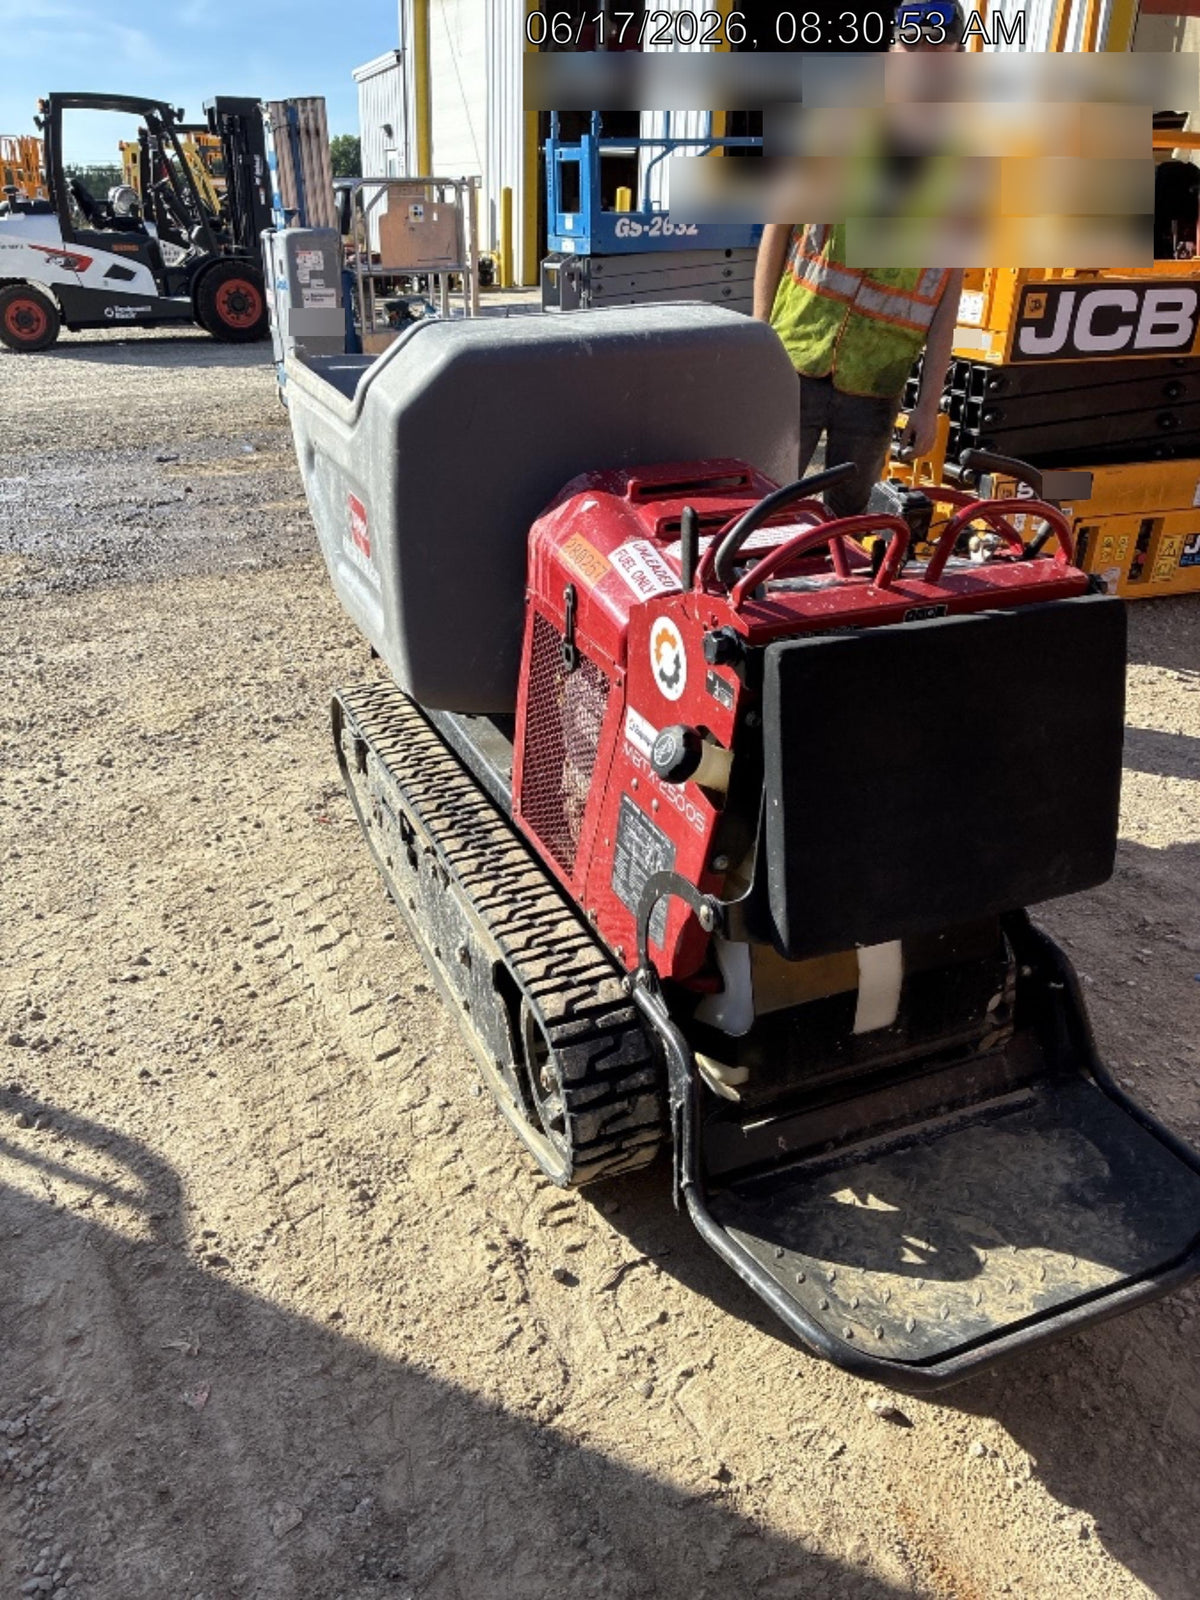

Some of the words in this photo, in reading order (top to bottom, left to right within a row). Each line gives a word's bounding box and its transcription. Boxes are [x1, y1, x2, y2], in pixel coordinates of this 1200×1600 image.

[1018, 288, 1198, 355] JCB
[616, 548, 636, 573] FUEL
[631, 570, 656, 594] ONLY
[632, 543, 675, 588] UNLEADED
